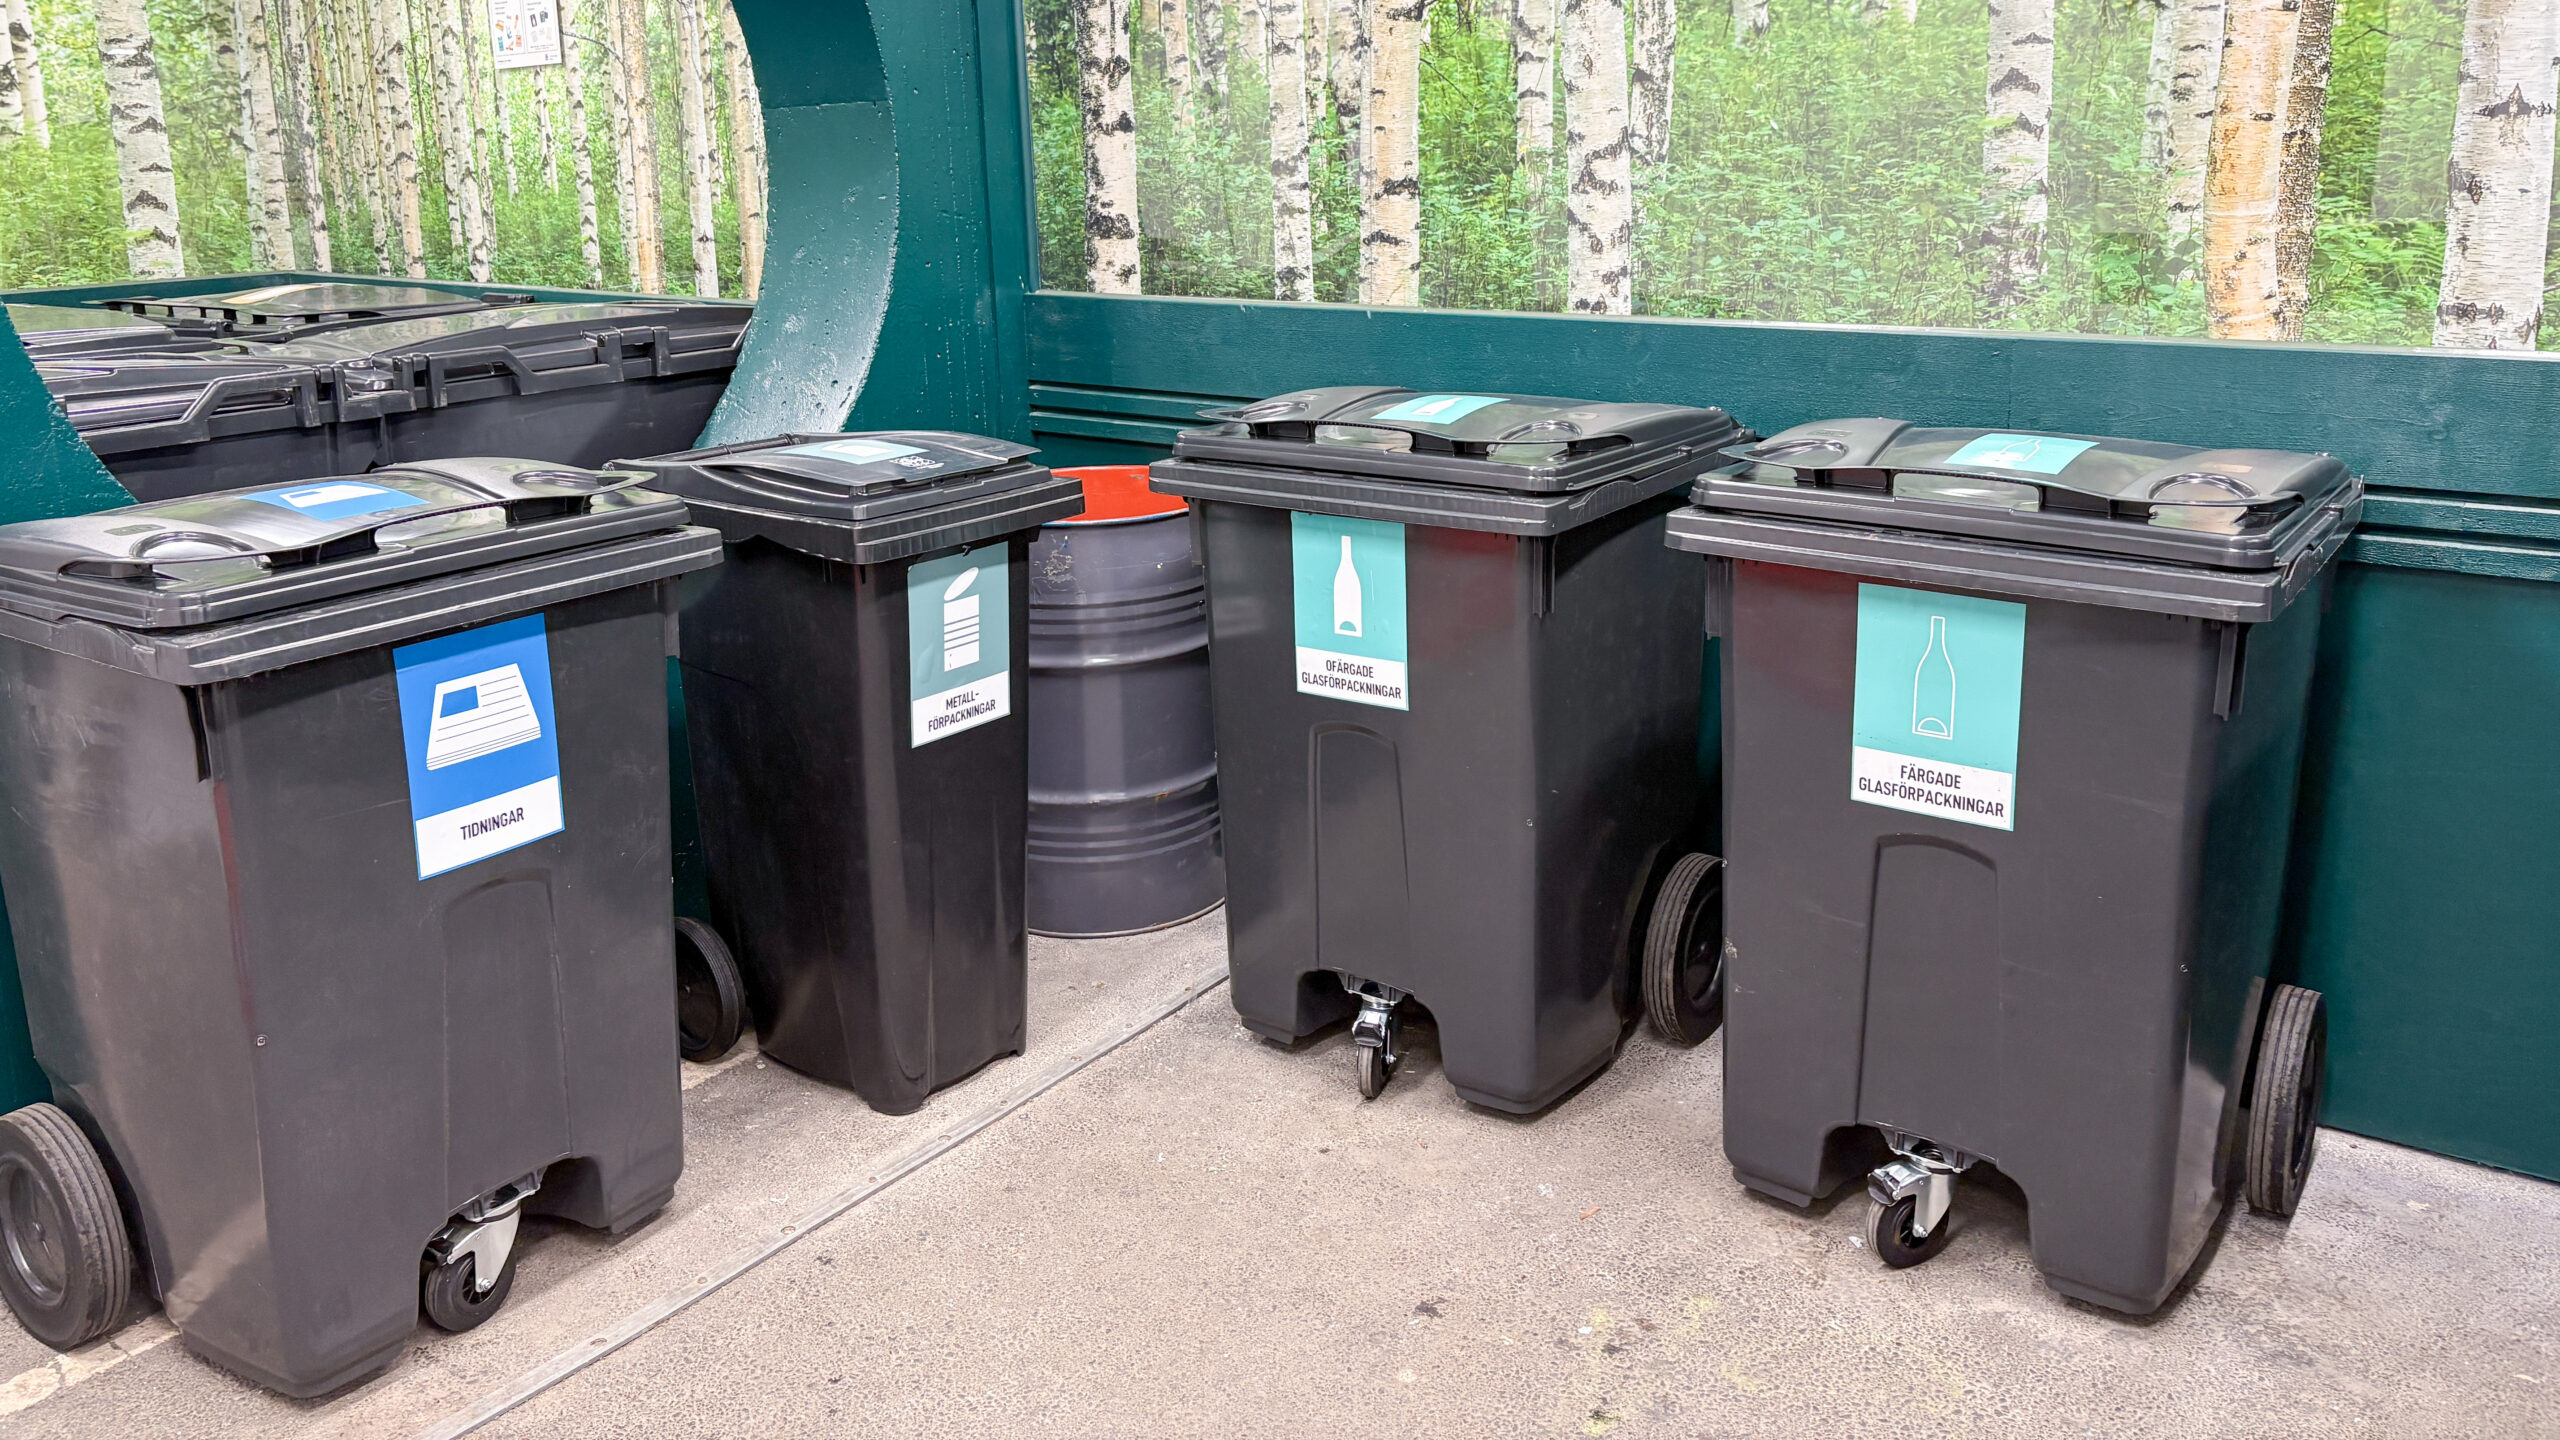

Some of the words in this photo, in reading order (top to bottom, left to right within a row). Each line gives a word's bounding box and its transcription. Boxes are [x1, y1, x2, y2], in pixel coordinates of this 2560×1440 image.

[1325, 658, 1374, 679] OFÄRGADE
[1301, 671, 1402, 700] GLASFÖRPACKNINGAR
[945, 690, 980, 711] METALL-
[928, 699, 996, 733] FÖRPACKNINGAR
[1900, 763, 1962, 790] FÄRGADE
[1858, 777, 2004, 818] GLASFÖRPACKNINGAR
[460, 807, 525, 840] TIDNINGAR
